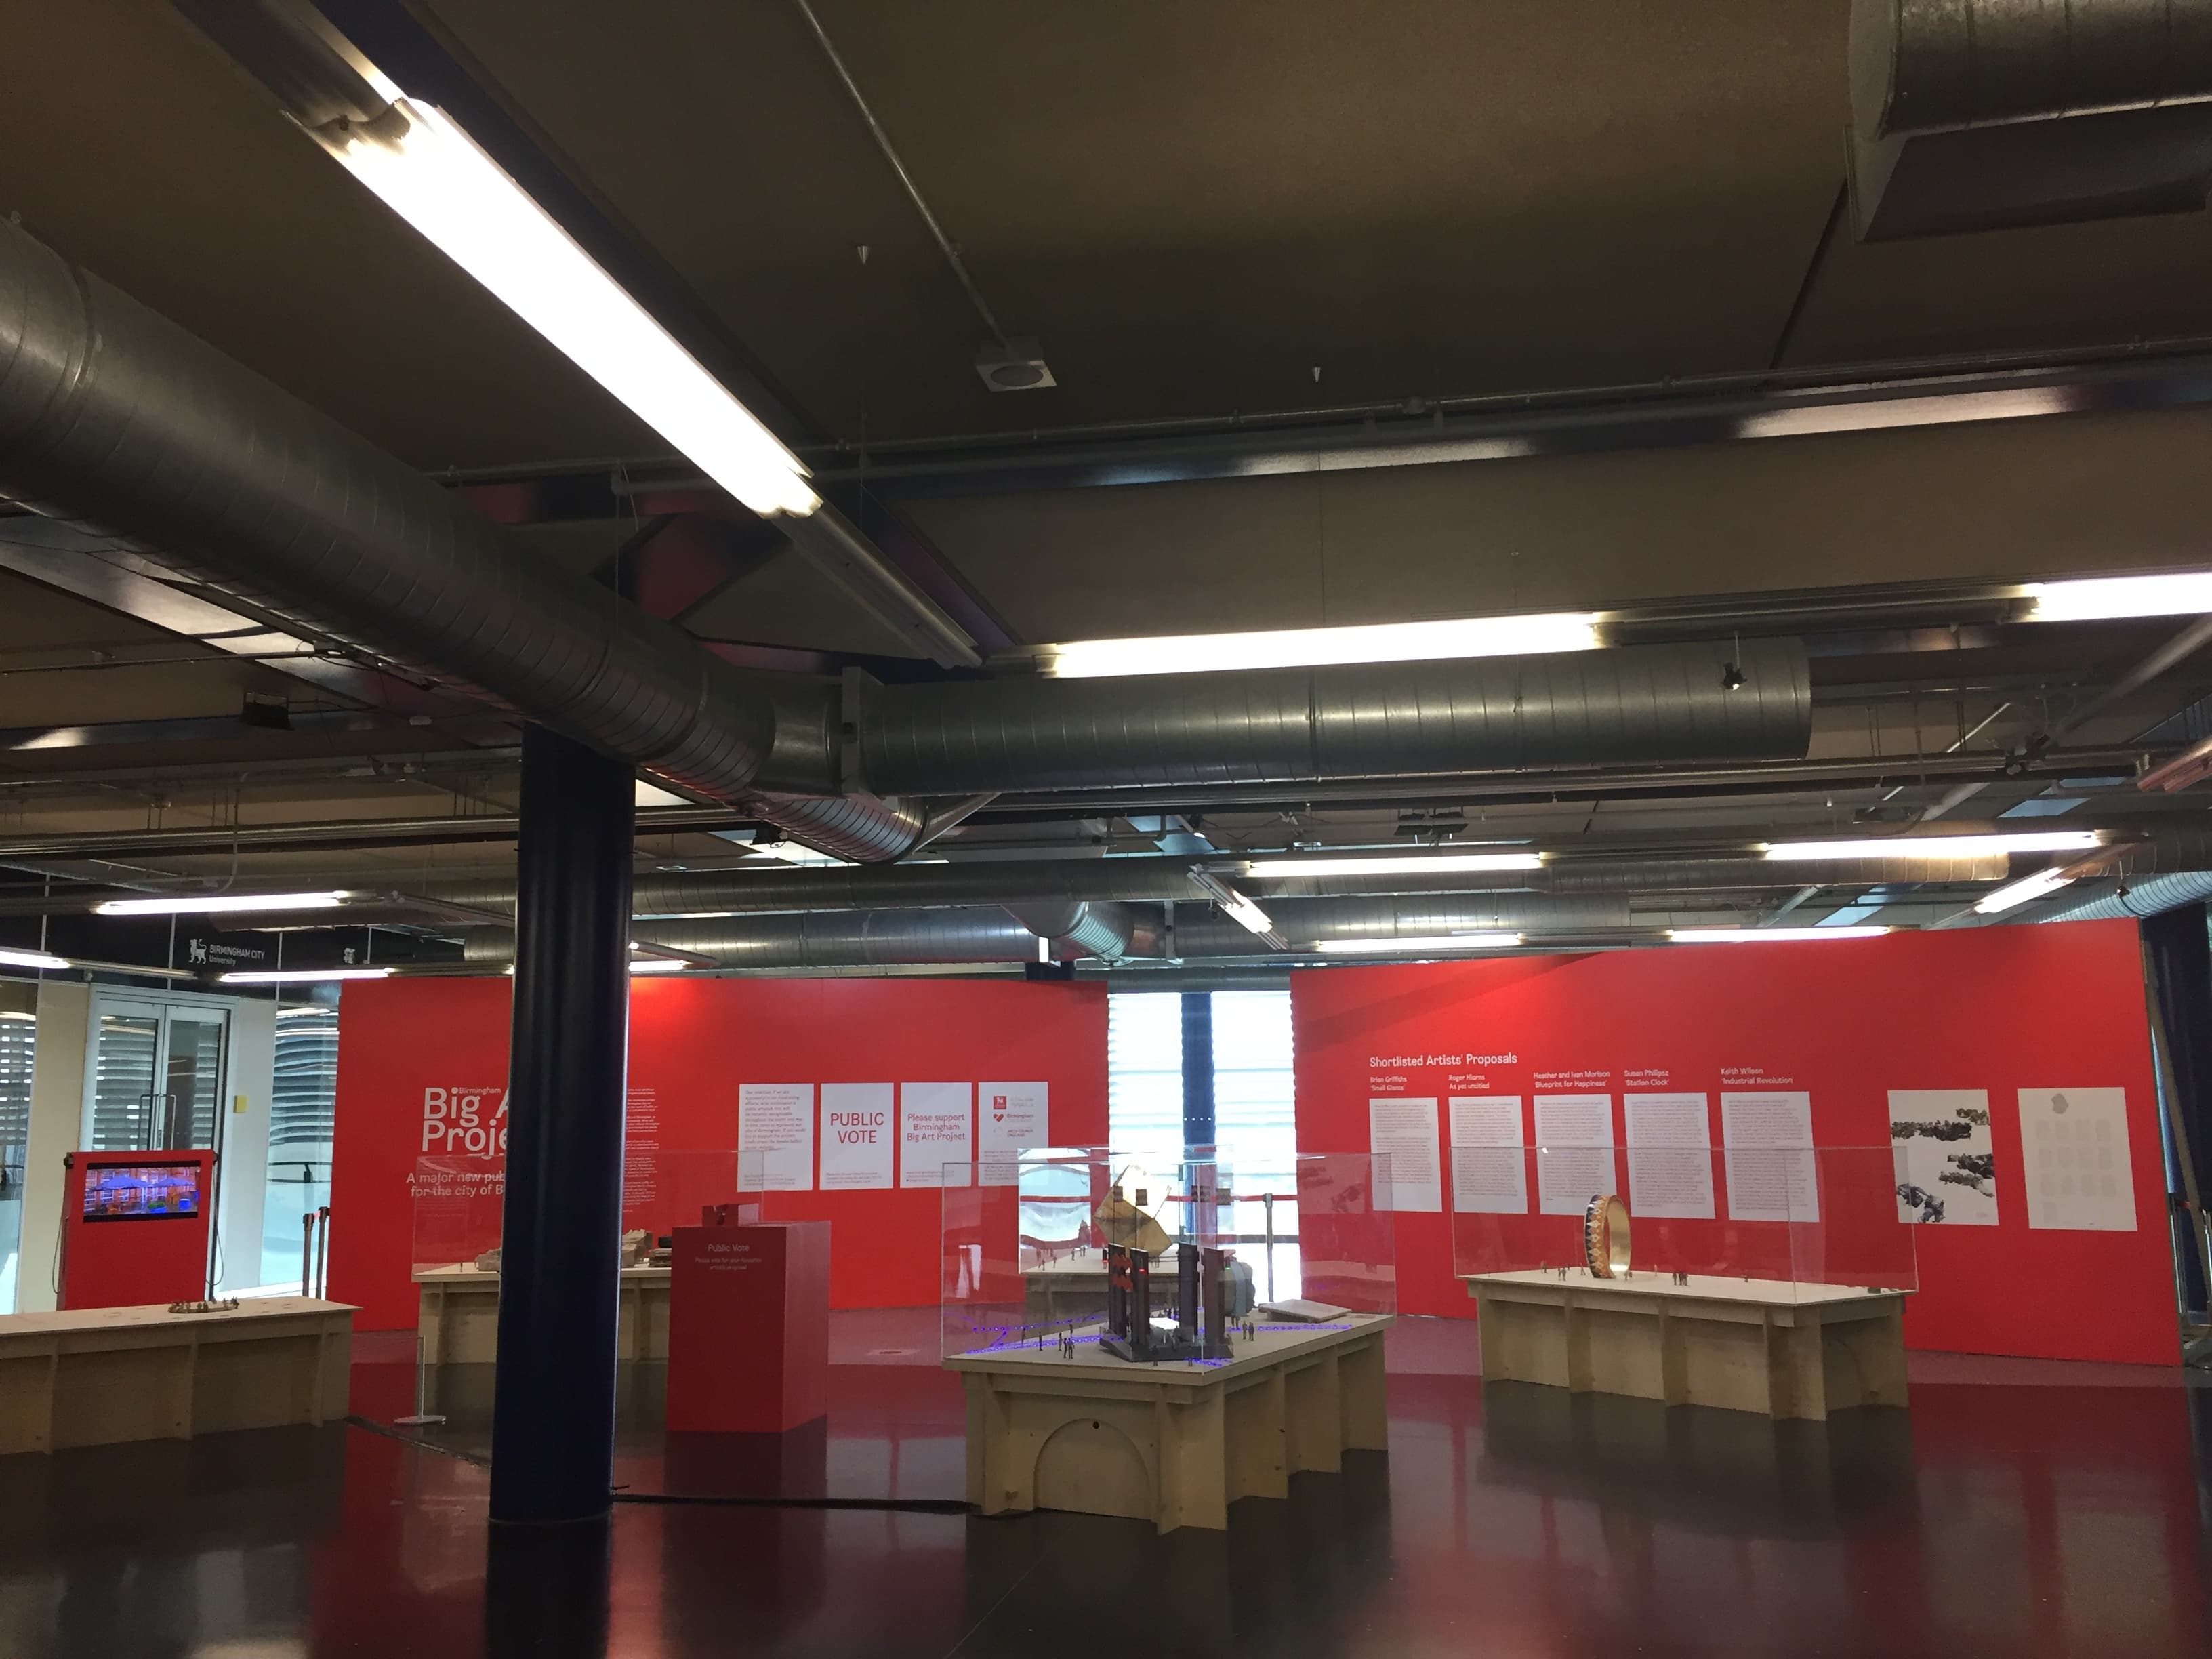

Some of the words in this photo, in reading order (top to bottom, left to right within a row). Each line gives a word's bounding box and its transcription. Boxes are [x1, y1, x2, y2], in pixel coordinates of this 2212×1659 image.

[209, 944, 251, 958] BIRMINGHAM
[251, 950, 265, 960] CITY
[209, 955, 236, 966] University
[1370, 1056, 1423, 1068] Shortlisted
[1426, 1054, 1463, 1066] Artists'
[1466, 1052, 1517, 1067] Proposals
[459, 1087, 501, 1095] Birmingham
[424, 1087, 481, 1127] Big
[830, 1112, 884, 1126] PUBLIC
[907, 1113, 933, 1122] Please
[935, 1113, 965, 1123] support
[913, 1123, 960, 1132] Birmingham
[422, 1119, 508, 1160] Proj
[838, 1130, 877, 1144] VOTE
[907, 1132, 920, 1143] Big
[921, 1132, 935, 1141] Art
[936, 1132, 966, 1142] Project
[406, 1173, 415, 1183] A
[419, 1172, 454, 1185] major
[457, 1173, 480, 1182] new
[485, 1170, 506, 1184] pub
[411, 1186, 430, 1197] for
[432, 1185, 451, 1196] the
[455, 1185, 477, 1197] city
[480, 1184, 493, 1195] of
[708, 1243, 731, 1252] Public
[732, 1243, 749, 1252] Vote
